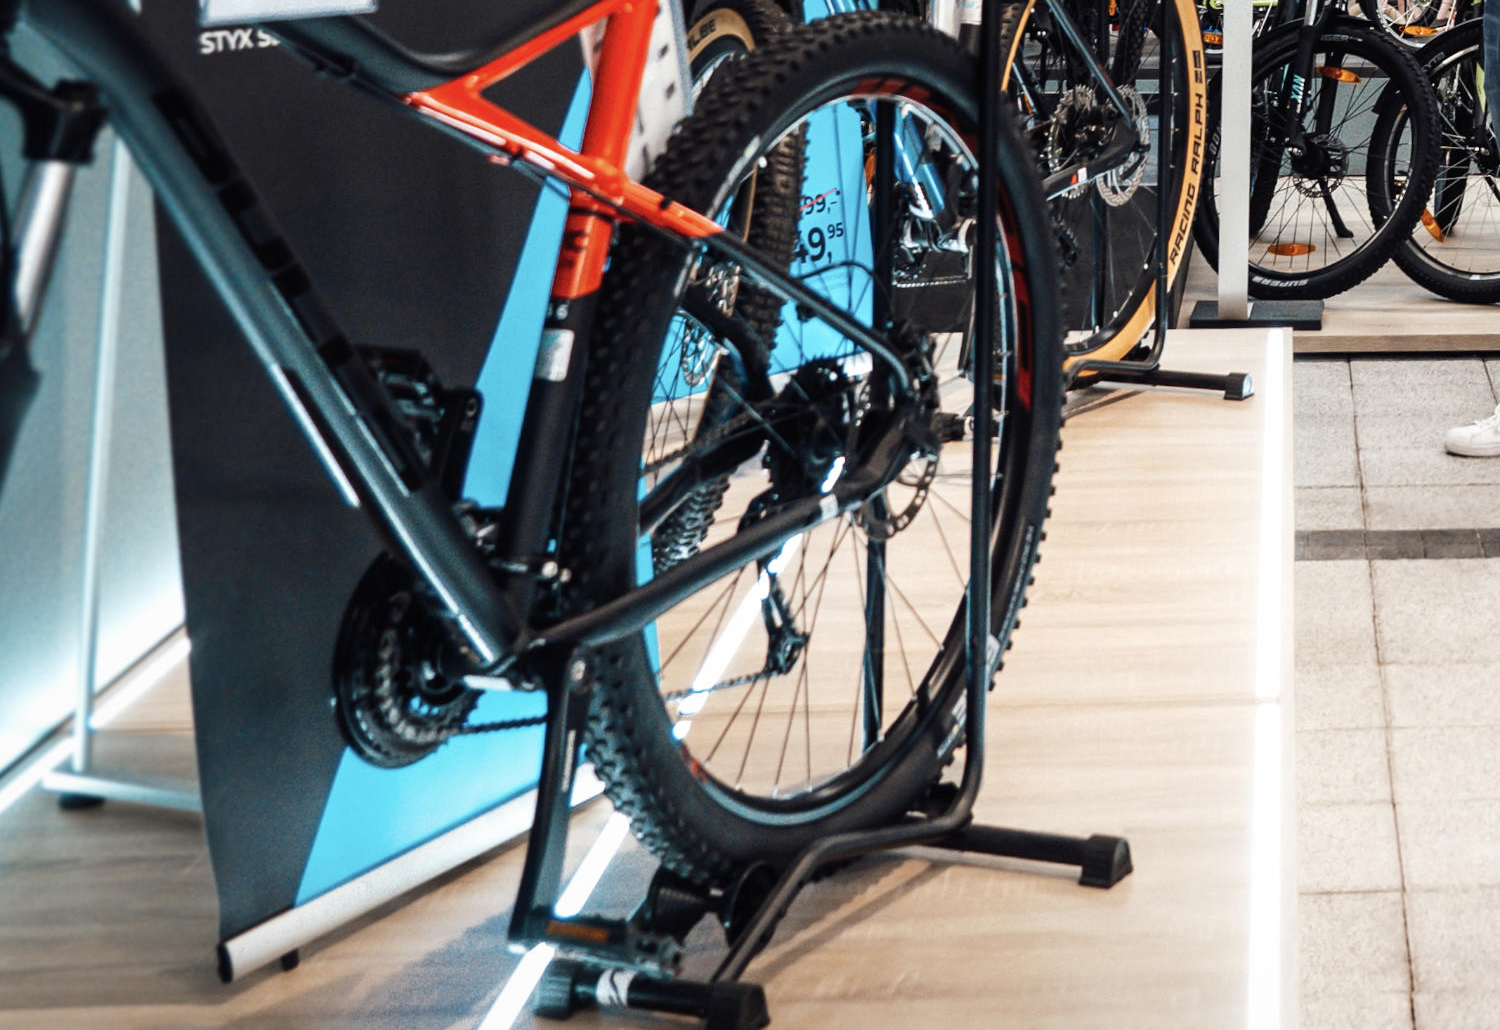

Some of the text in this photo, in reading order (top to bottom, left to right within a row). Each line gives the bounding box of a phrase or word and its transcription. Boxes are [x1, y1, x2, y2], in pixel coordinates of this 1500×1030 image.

[200, 28, 255, 55] STYX
[1169, 183, 1196, 265] RACING
[1190, 92, 1205, 176] RALPH
[827, 222, 845, 240] 95
